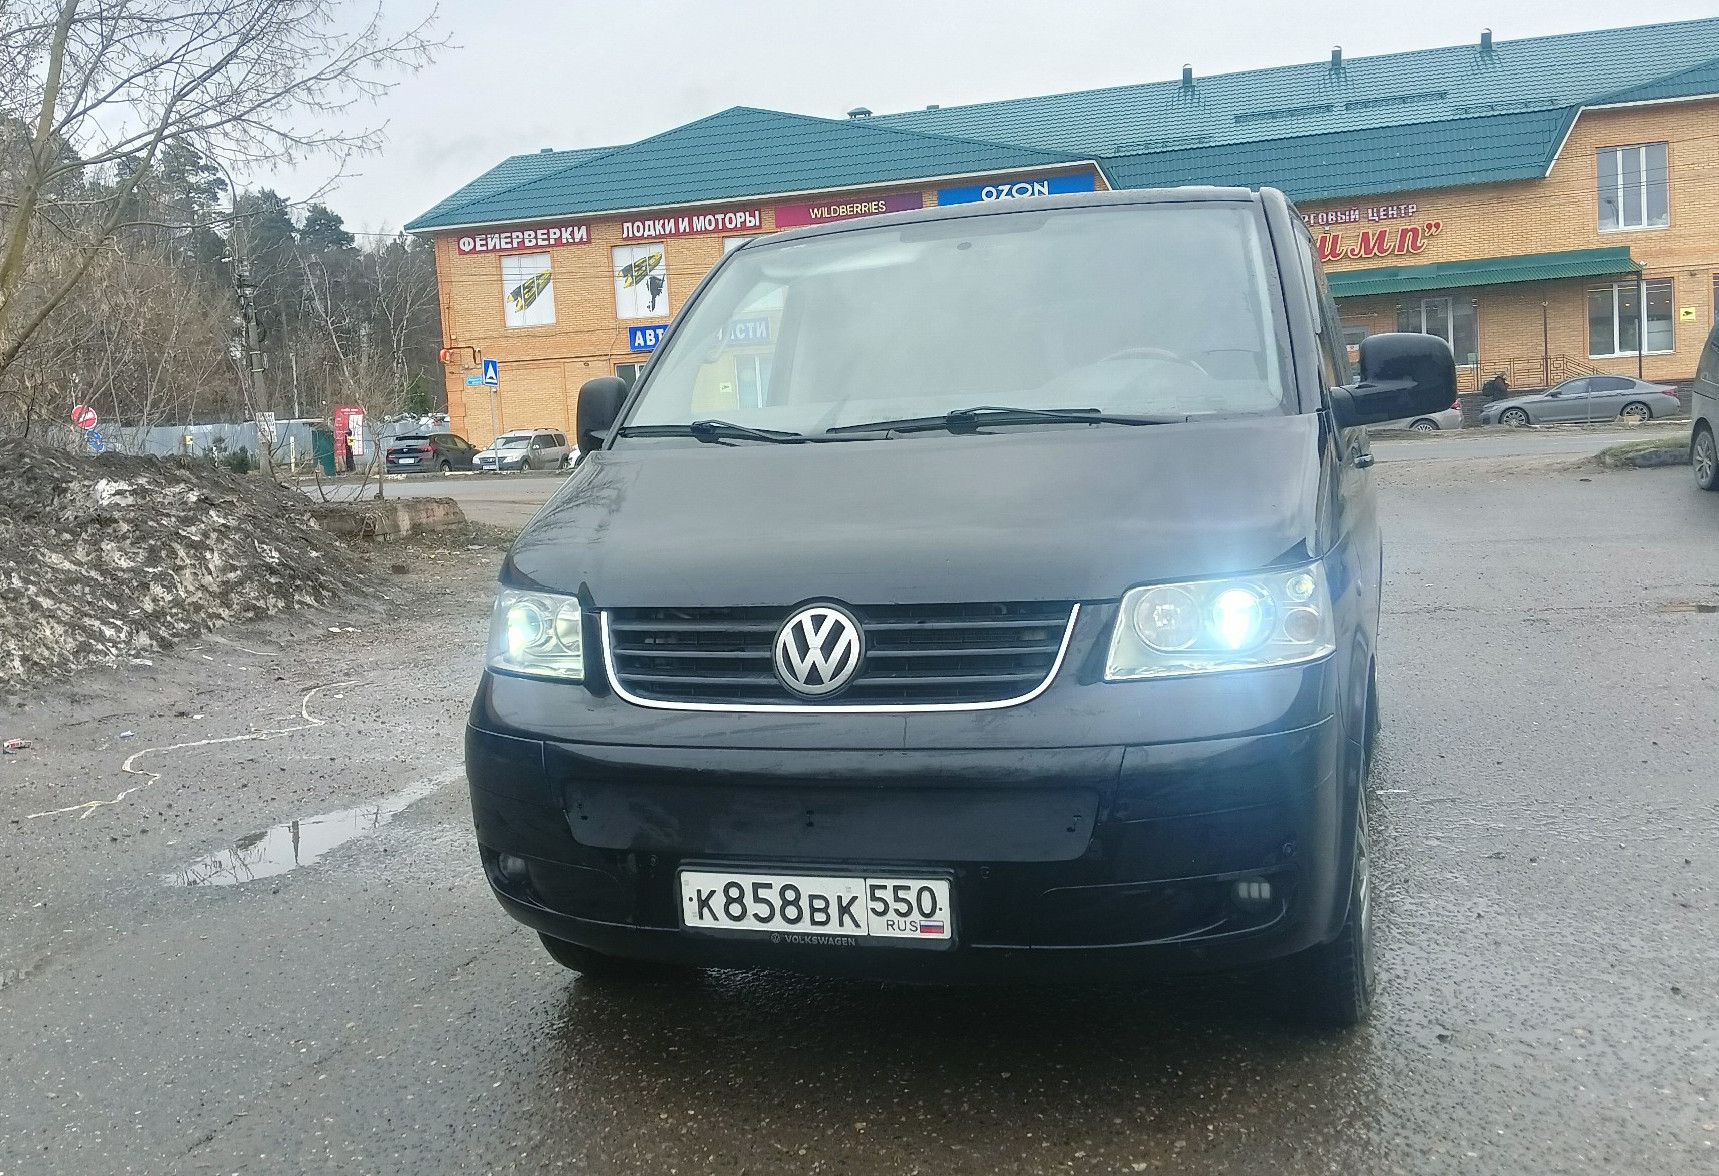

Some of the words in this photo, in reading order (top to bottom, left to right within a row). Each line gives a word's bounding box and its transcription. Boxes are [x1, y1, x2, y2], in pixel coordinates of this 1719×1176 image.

[981, 180, 1049, 202] OZON
[809, 200, 886, 219] WILDBERRIES
[1301, 207, 1360, 226] РГОВЫЙ
[1367, 203, 1417, 221] ЦЕНТР
[622, 218, 675, 239] ЛОДКИ
[678, 217, 690, 234] И
[693, 210, 761, 231] МОТОРЫ
[458, 225, 588, 252] ФЕЙЕРВЕРКИ
[696, 880, 862, 929] К858ВК
[869, 884, 938, 919] 550
[886, 920, 918, 933] RUS
[784, 934, 856, 947] VOLKSWAGEN
